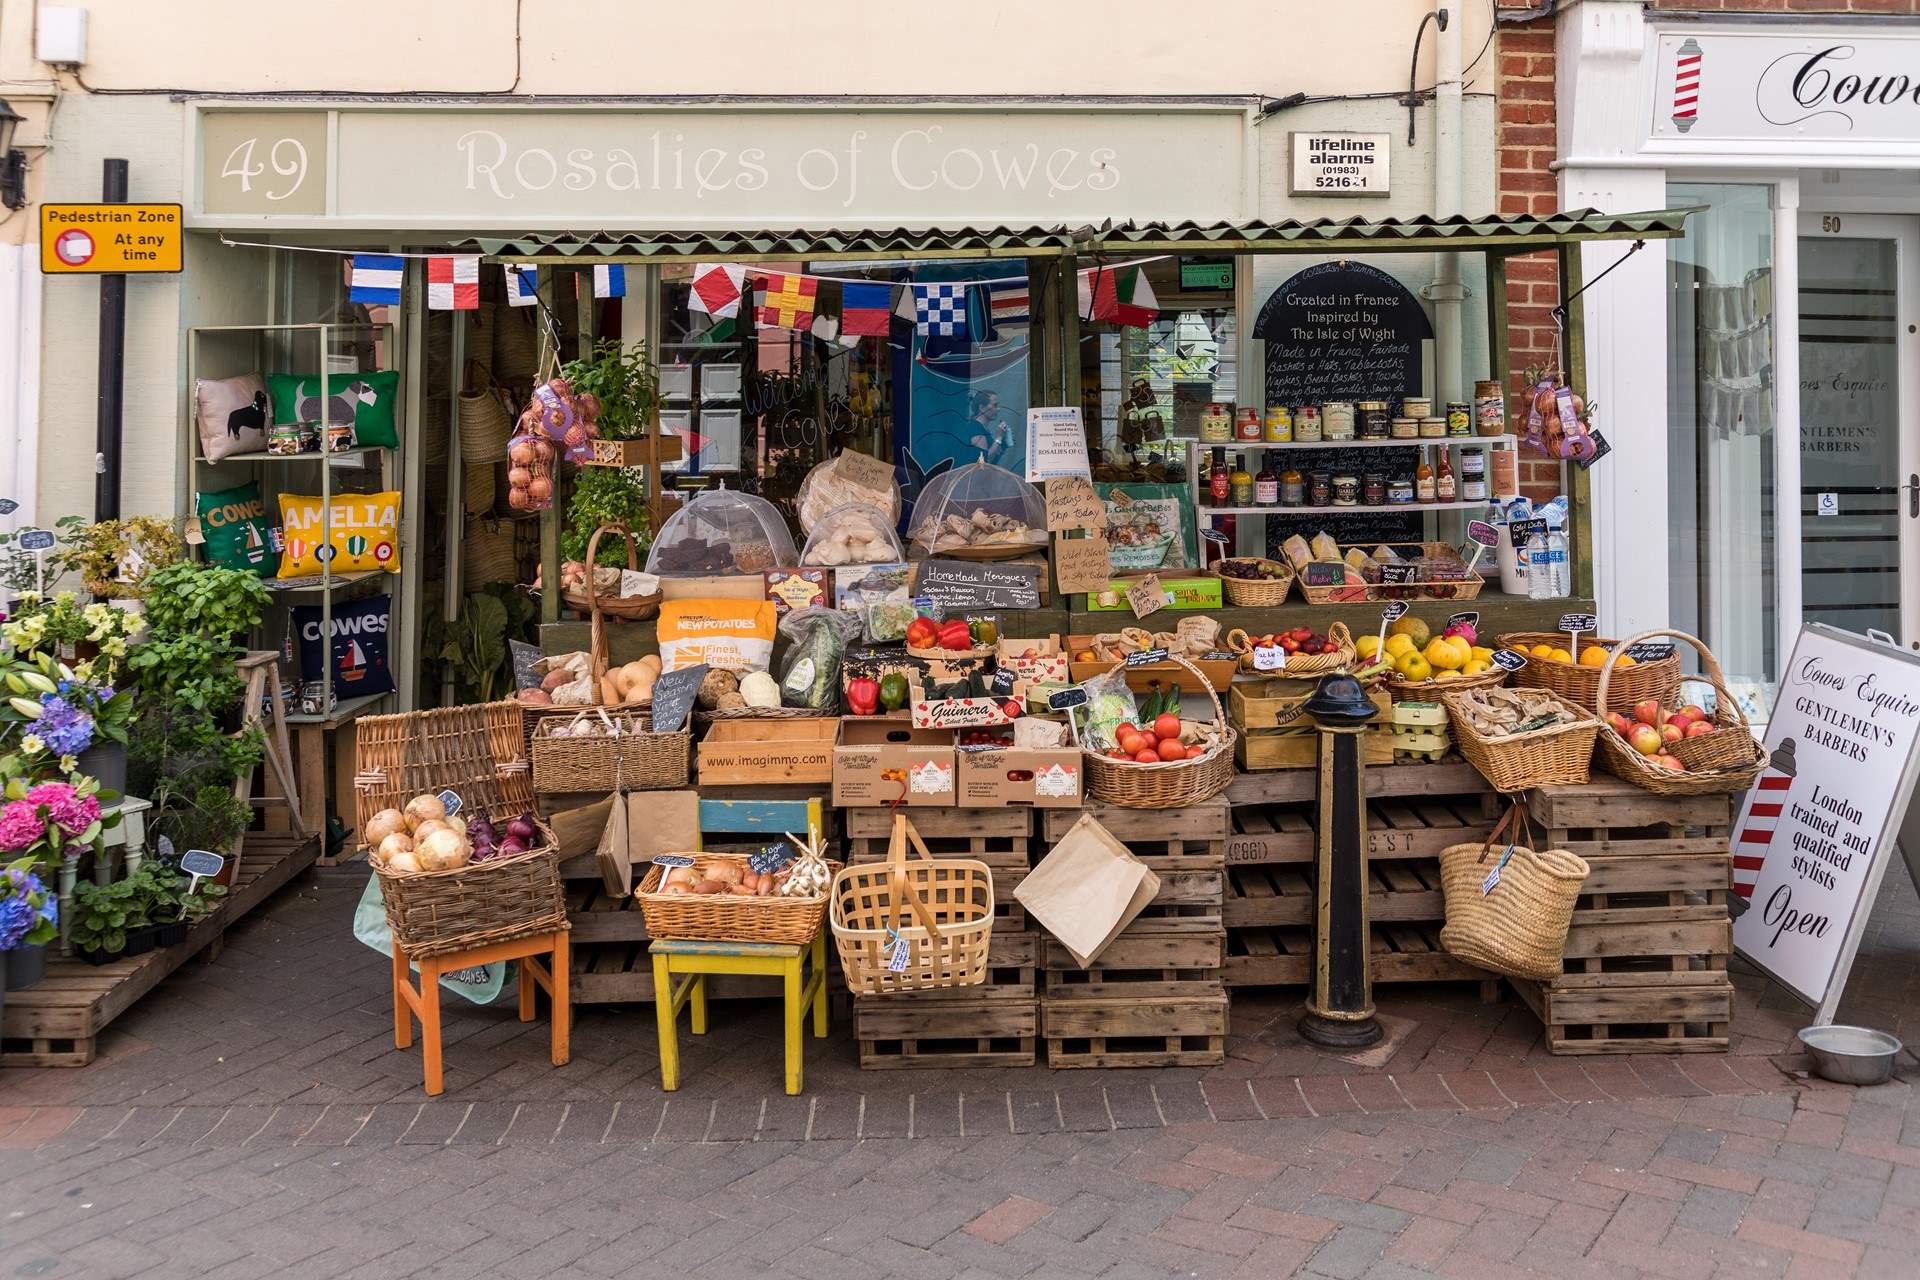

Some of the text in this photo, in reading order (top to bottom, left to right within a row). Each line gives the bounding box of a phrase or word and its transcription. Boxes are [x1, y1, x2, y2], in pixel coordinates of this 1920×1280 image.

[1309, 138, 1375, 151] lifeline
[1310, 152, 1375, 164] alarms
[220, 137, 308, 200] 49
[457, 125, 1121, 207] Rosalies of Cowes
[1322, 166, 1360, 175] (01983)
[1315, 176, 1367, 187] 52161
[48, 210, 175, 223] Pedestrian Zone
[1822, 215, 1842, 234] 50
[114, 233, 165, 247] At any
[122, 248, 157, 261] time
[1286, 293, 1400, 307] Created in France
[1306, 311, 1379, 325] Inspired by
[1290, 327, 1396, 342] The Isle of Wight
[1309, 346, 1322, 358] in
[781, 395, 858, 449] Cowes
[285, 504, 397, 530] AMELIA
[983, 570, 1026, 584] Meringues
[677, 620, 701, 631] NEW
[703, 618, 756, 630] POTATOES
[705, 644, 739, 655] Finest
[656, 674, 686, 690] New
[1791, 656, 1919, 719] Cowes Esquire
[931, 702, 990, 723] Guimera
[1795, 695, 1896, 748] GENTLEMEN'S
[1803, 723, 1868, 764] BARBERS
[706, 754, 828, 769] www.imagimmo.com
[1810, 784, 1863, 827] London
[1790, 800, 1873, 857] trained and
[1792, 831, 1853, 873] qualified
[1790, 854, 1837, 893] stylists
[1762, 883, 1834, 949] Open
